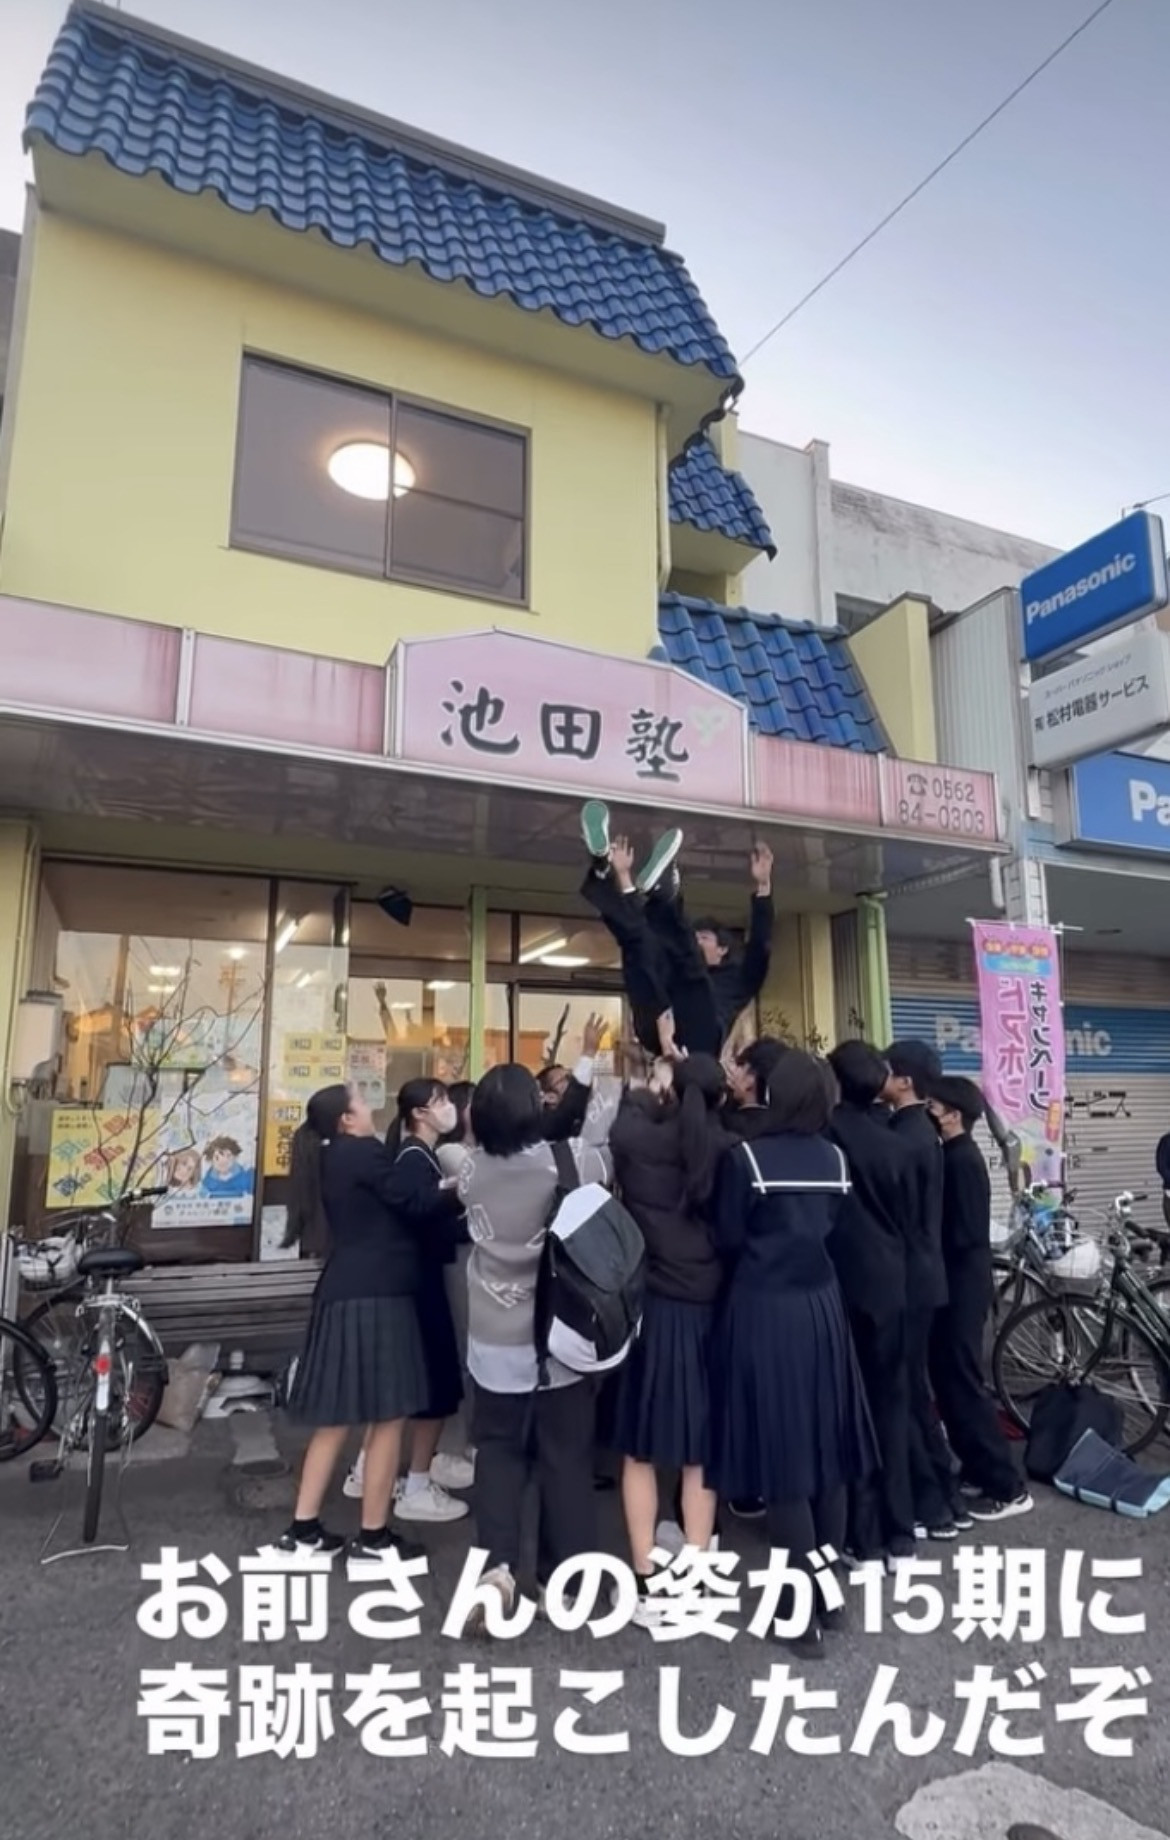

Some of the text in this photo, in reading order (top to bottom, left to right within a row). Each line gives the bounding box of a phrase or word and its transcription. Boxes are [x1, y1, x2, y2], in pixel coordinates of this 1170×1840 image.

[1026, 552, 1136, 625] Panasonic
[440, 680, 690, 783] 池田塾
[898, 799, 986, 834] 84-0303
[932, 777, 975, 804] 0562
